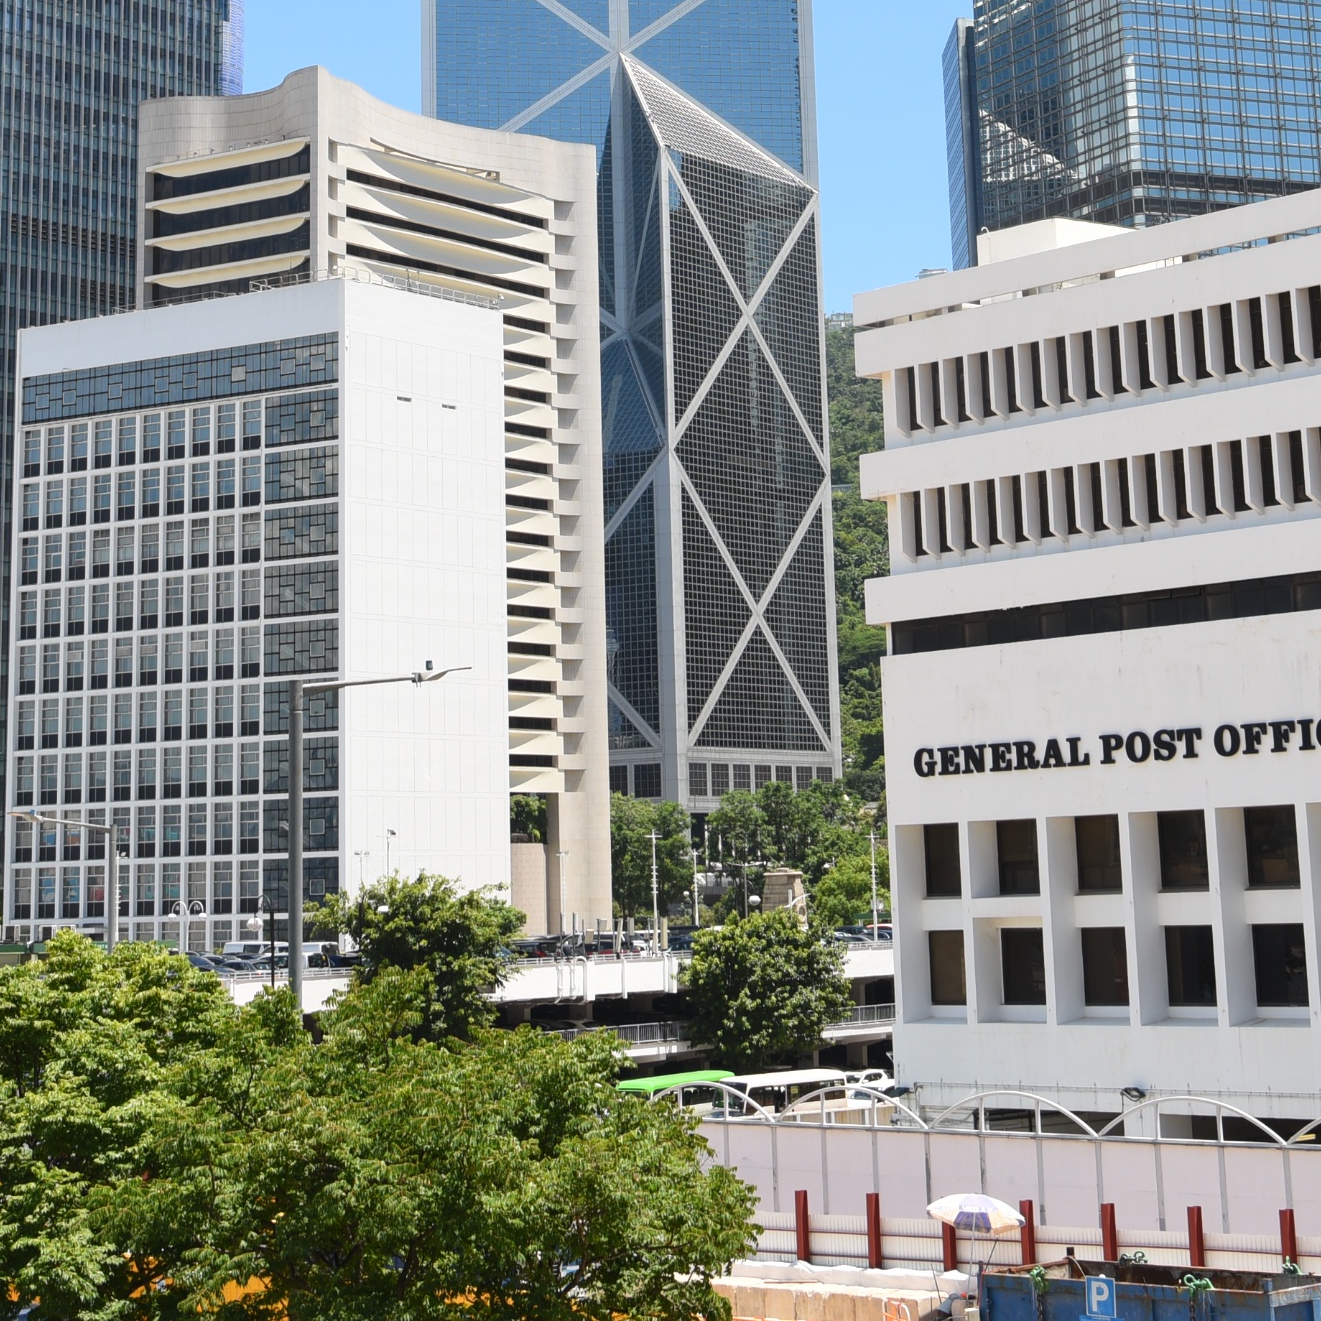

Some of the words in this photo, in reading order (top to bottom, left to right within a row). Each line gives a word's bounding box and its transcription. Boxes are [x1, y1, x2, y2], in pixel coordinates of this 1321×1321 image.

[914, 737, 1090, 777] GENERAL
[1099, 728, 1202, 764] POST
[1091, 1280, 1109, 1312] P
